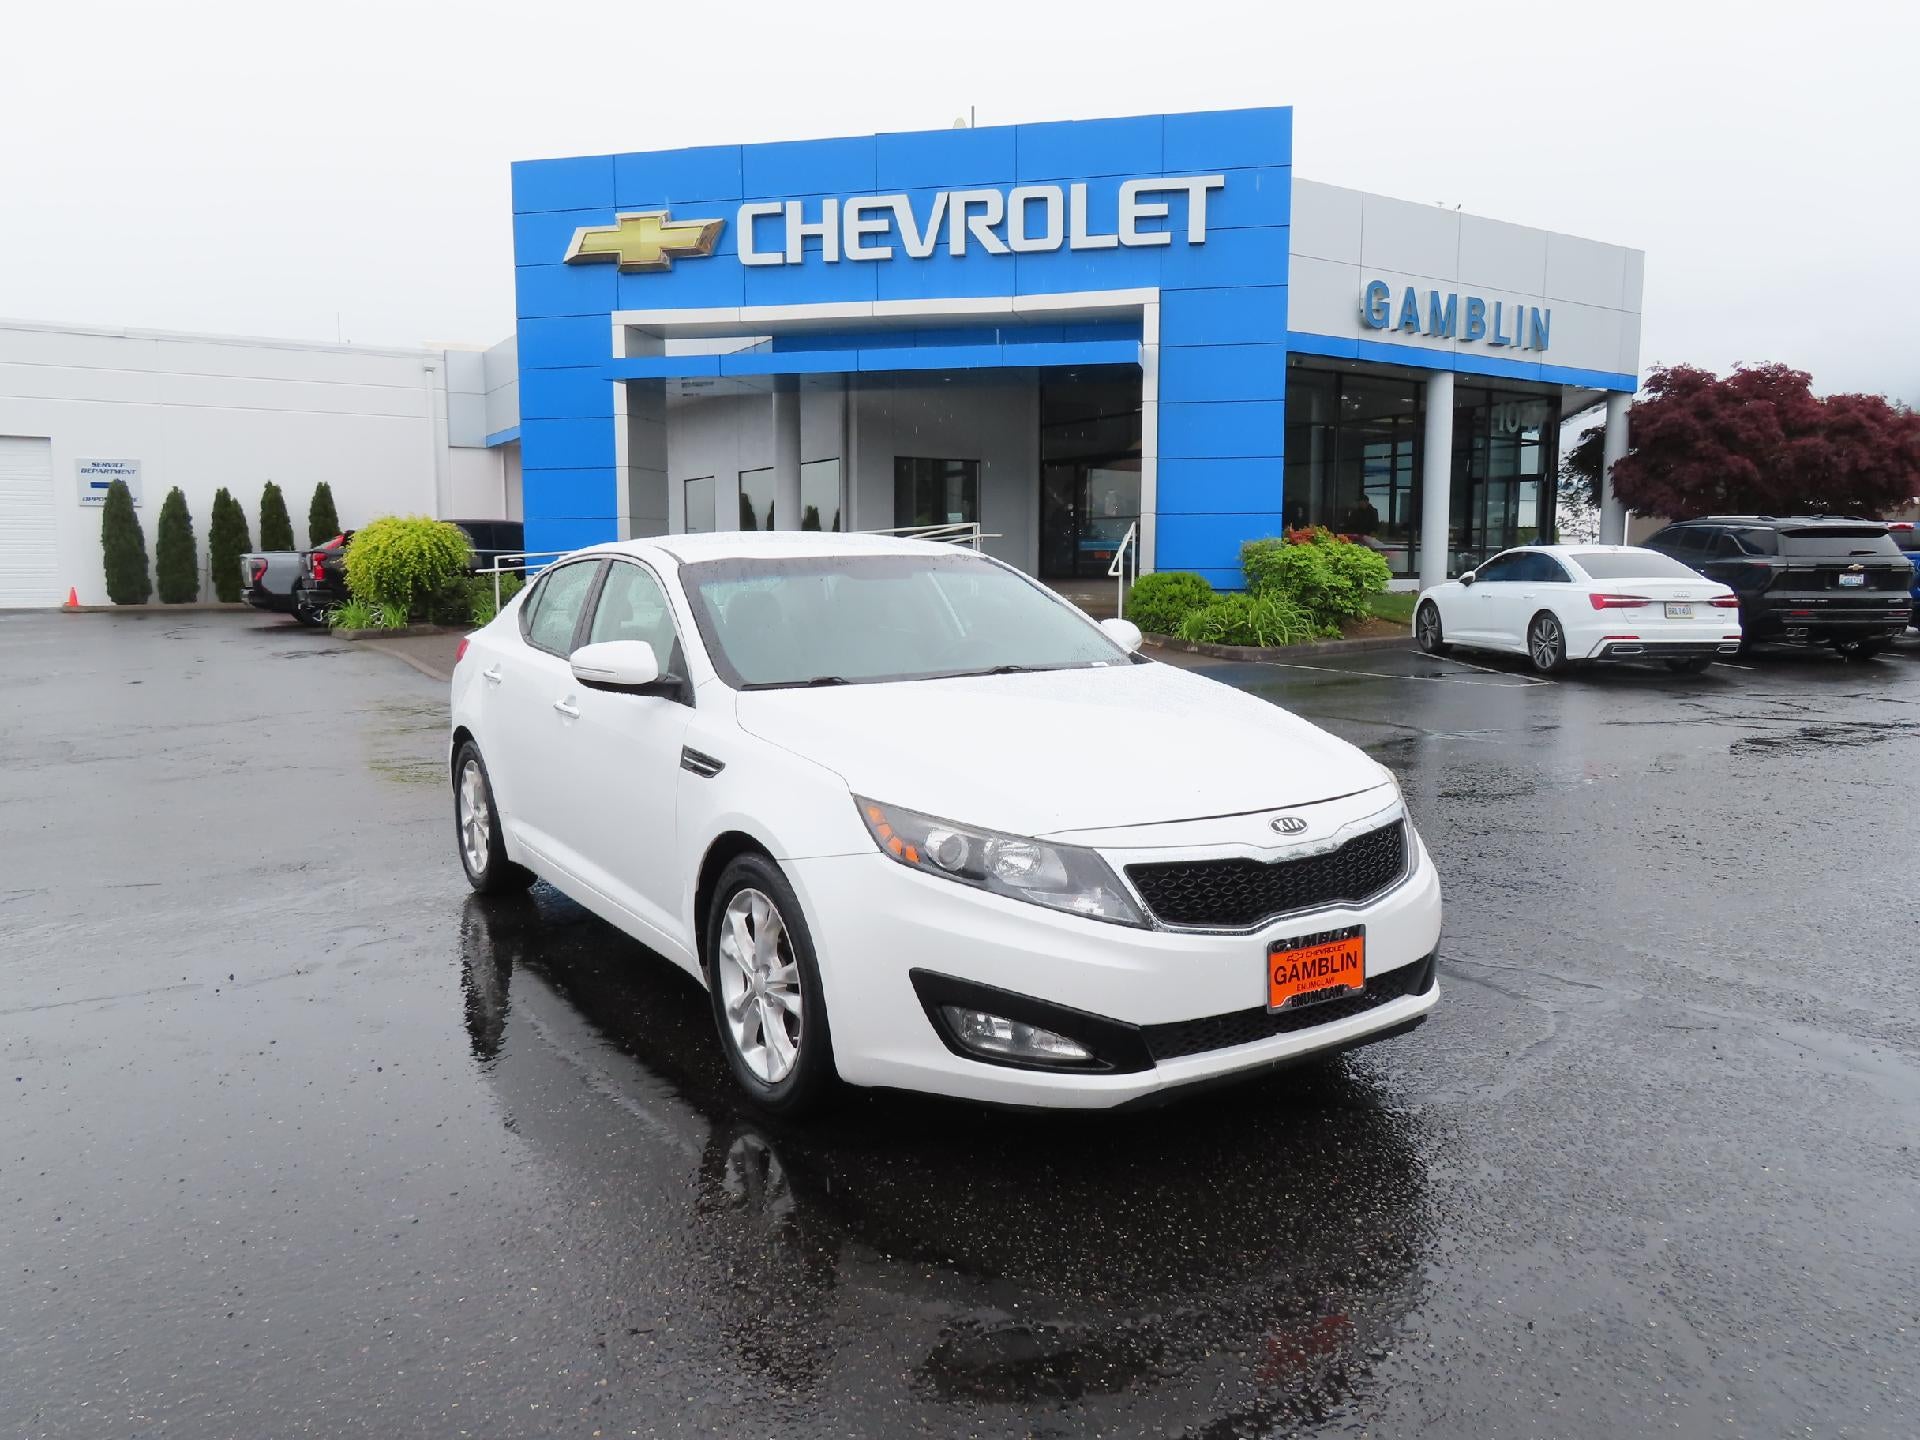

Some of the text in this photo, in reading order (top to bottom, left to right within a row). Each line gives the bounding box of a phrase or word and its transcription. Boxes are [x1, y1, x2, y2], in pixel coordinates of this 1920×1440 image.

[736, 174, 1225, 266] CHEVROLET
[1361, 279, 1550, 352] GAMBLIN
[1273, 818, 1305, 832] KIA
[1273, 950, 1358, 986] GAMBLIN
[1305, 943, 1347, 958] CHEVROLET
